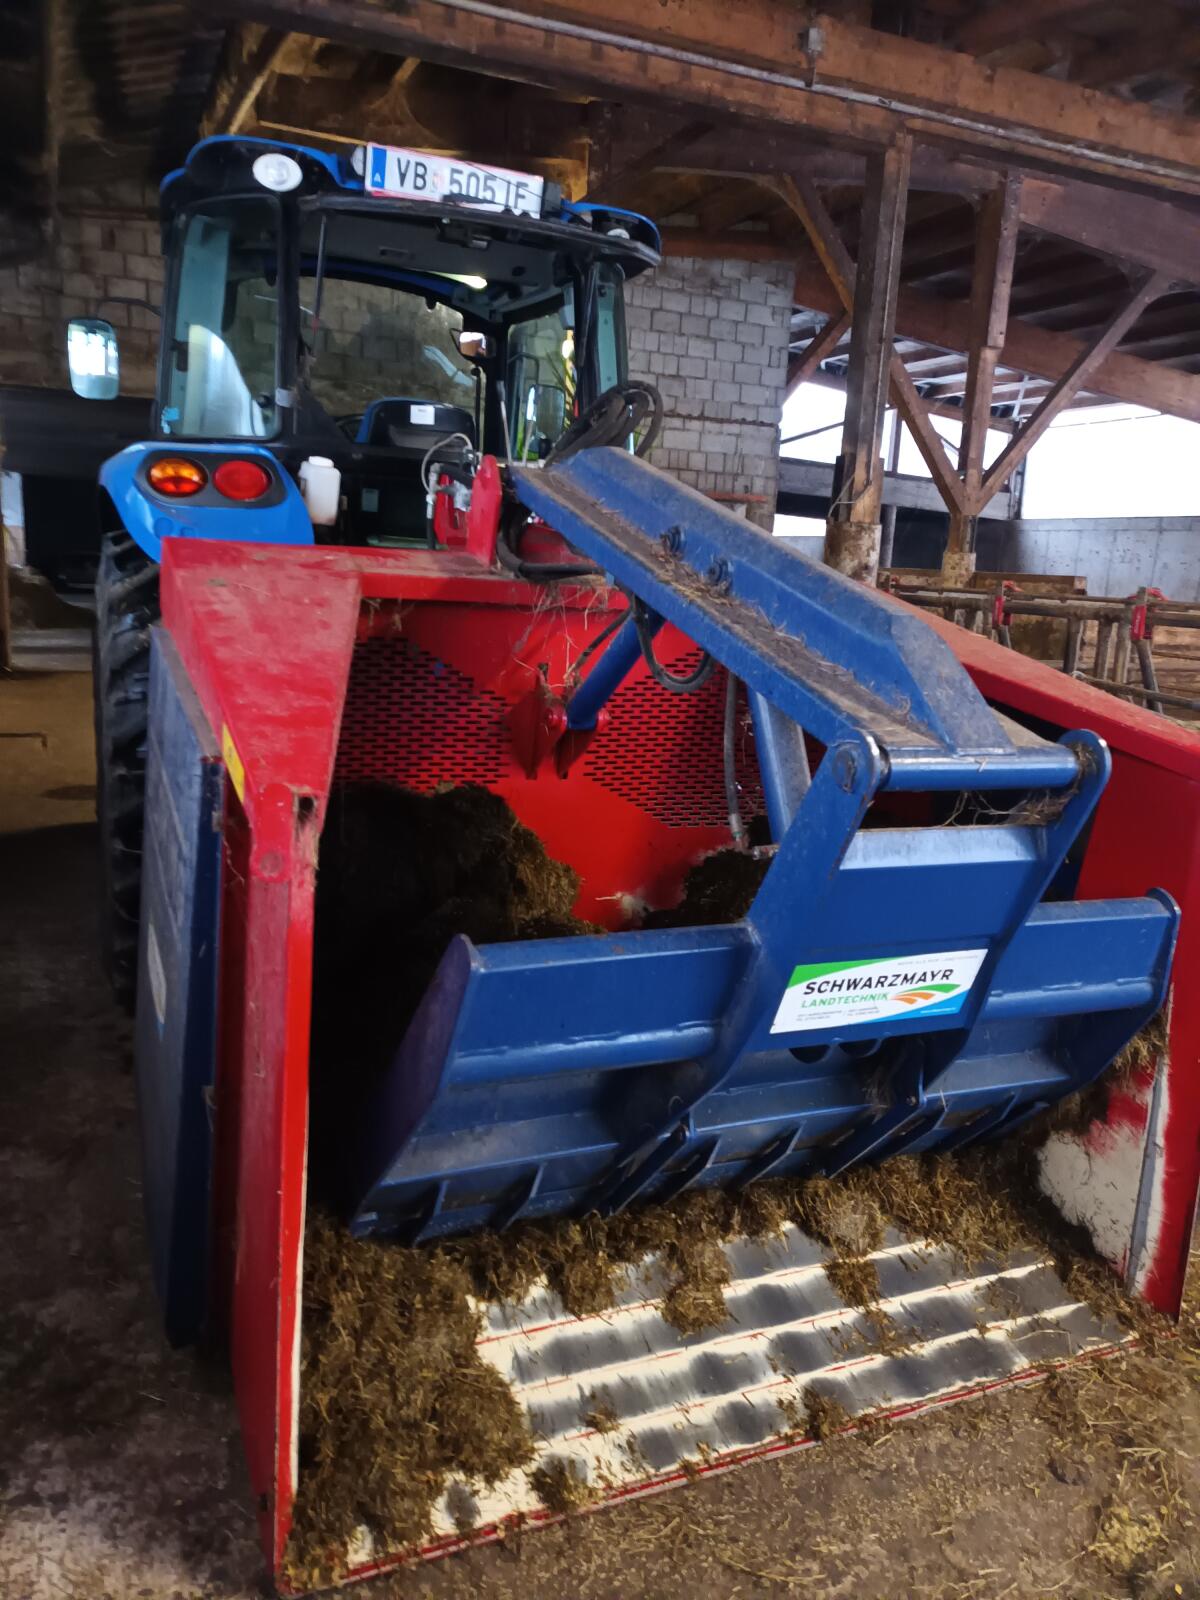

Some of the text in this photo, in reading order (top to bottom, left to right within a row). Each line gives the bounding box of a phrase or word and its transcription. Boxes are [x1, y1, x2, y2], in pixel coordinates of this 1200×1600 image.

[397, 157, 428, 191] VB
[449, 167, 498, 203] 505
[803, 968, 954, 995] SCHWARZMAYR
[801, 992, 890, 1009] LANDTECHNIK
